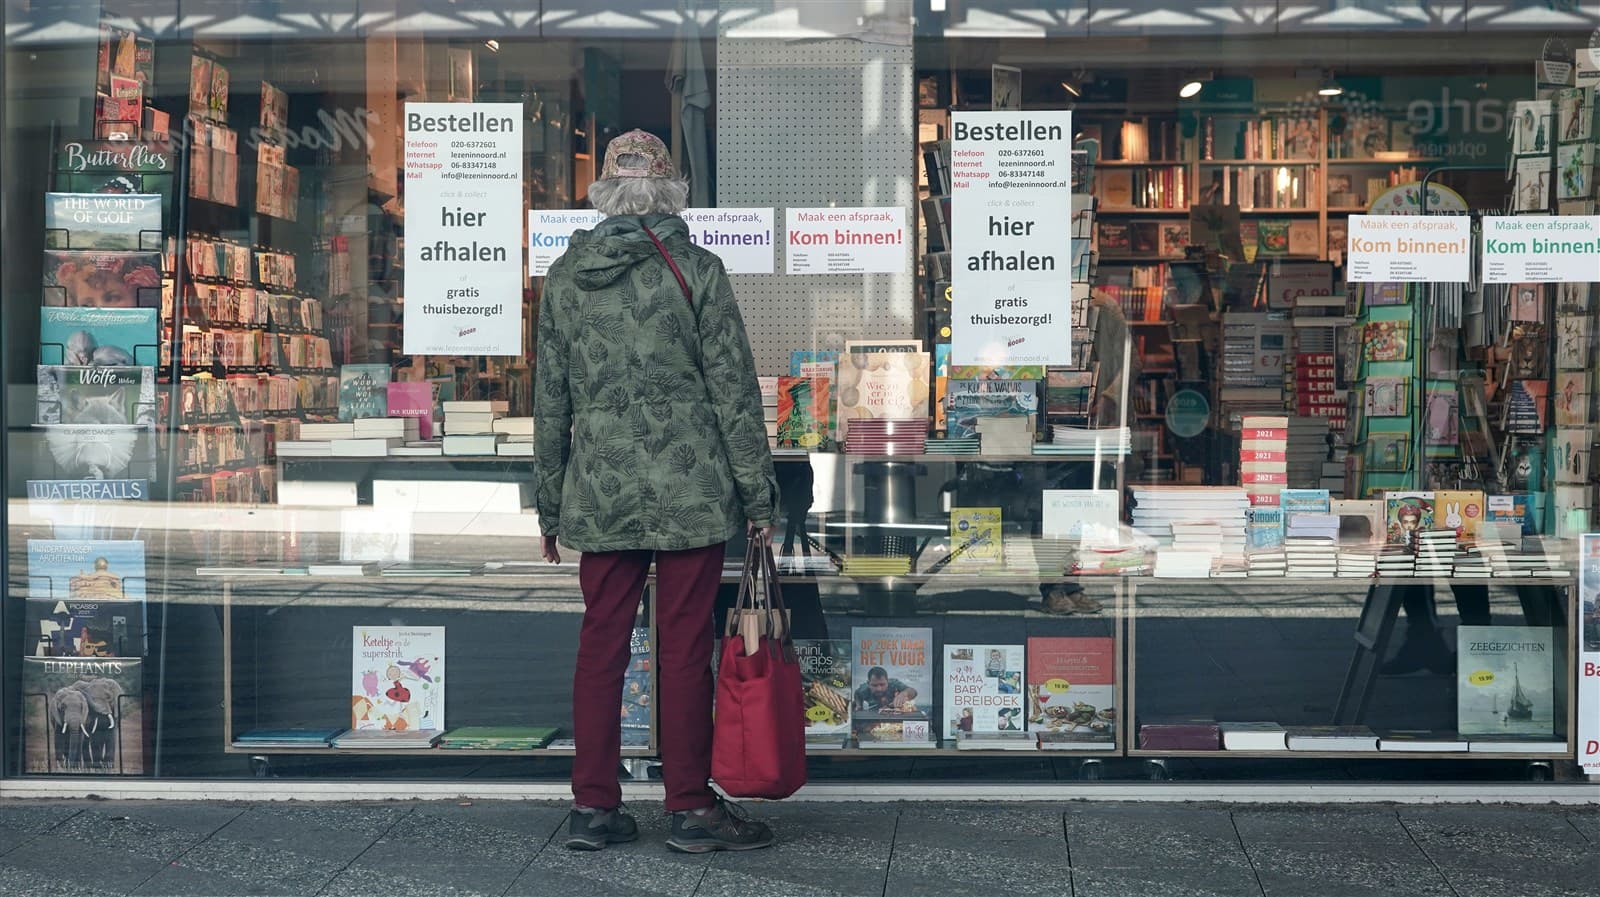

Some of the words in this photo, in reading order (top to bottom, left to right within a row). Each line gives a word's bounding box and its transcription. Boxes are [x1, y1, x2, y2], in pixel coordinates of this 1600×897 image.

[408, 112, 513, 132] Bestellen
[955, 120, 1062, 141] Bestellen
[65, 143, 168, 173] Butterflies
[407, 151, 436, 159] Internet
[451, 151, 507, 159] lezeninnoord.nl
[407, 162, 443, 170] Whatsapp
[998, 159, 1055, 167] lezeninnoord.nl
[441, 172, 518, 180] info@lezeninnoord.nl
[953, 171, 990, 179] Whatsapp
[998, 170, 1045, 178] 06-83347148
[988, 181, 1066, 189] info@lezeninnoord.nl
[64, 198, 89, 210] THE
[94, 198, 145, 210] WORLD
[74, 211, 93, 223] OF
[97, 211, 134, 223] GOLF
[441, 206, 486, 227] hier
[540, 215, 567, 223] Maak
[683, 213, 694, 222] ak
[696, 214, 714, 222] een
[717, 213, 762, 224] afspraak,
[798, 212, 825, 222] Maak
[828, 214, 846, 222] een
[849, 212, 894, 223] afspraak,
[989, 215, 1034, 236] hier
[1360, 219, 1389, 229] Maak
[1391, 221, 1409, 230] een
[1413, 220, 1458, 232] afspraak,
[1495, 221, 1522, 230] Maak
[1526, 222, 1544, 230] een
[1547, 220, 1593, 232] afspraak,
[532, 232, 570, 247] Kom
[703, 230, 770, 245] binnen!
[790, 230, 829, 245] Kom
[835, 229, 902, 245] binnen!
[420, 241, 506, 262] afhalen
[1351, 237, 1391, 253] Kom
[1398, 237, 1466, 254] binnen!
[1486, 239, 1526, 254] Kom
[967, 250, 1055, 271] afhalen
[447, 287, 480, 300] gratis
[994, 296, 1028, 309] gratis
[423, 303, 503, 317] thuisbezorgd!
[970, 313, 1052, 326] thuisbezorgd!
[80, 368, 118, 388] Wölfe
[866, 382, 885, 390] Wie
[867, 396, 884, 406] het
[1256, 430, 1273, 438] 2021
[34, 482, 143, 499] WATERFALLS
[1255, 495, 1273, 503] 2021
[363, 634, 394, 650] Keteltje
[861, 639, 871, 650] OP
[876, 639, 898, 650] ZOEK
[901, 639, 926, 650] NAAR
[1470, 642, 1545, 652] ZEEGEZICHTEN
[793, 644, 823, 656] anini,
[861, 651, 885, 666] HET
[890, 651, 926, 666] VUUR
[44, 662, 122, 674] ELEPHANTS
[949, 674, 983, 683] MAMA
[954, 684, 983, 694] BABY
[954, 695, 1019, 706] BREIBOEK
